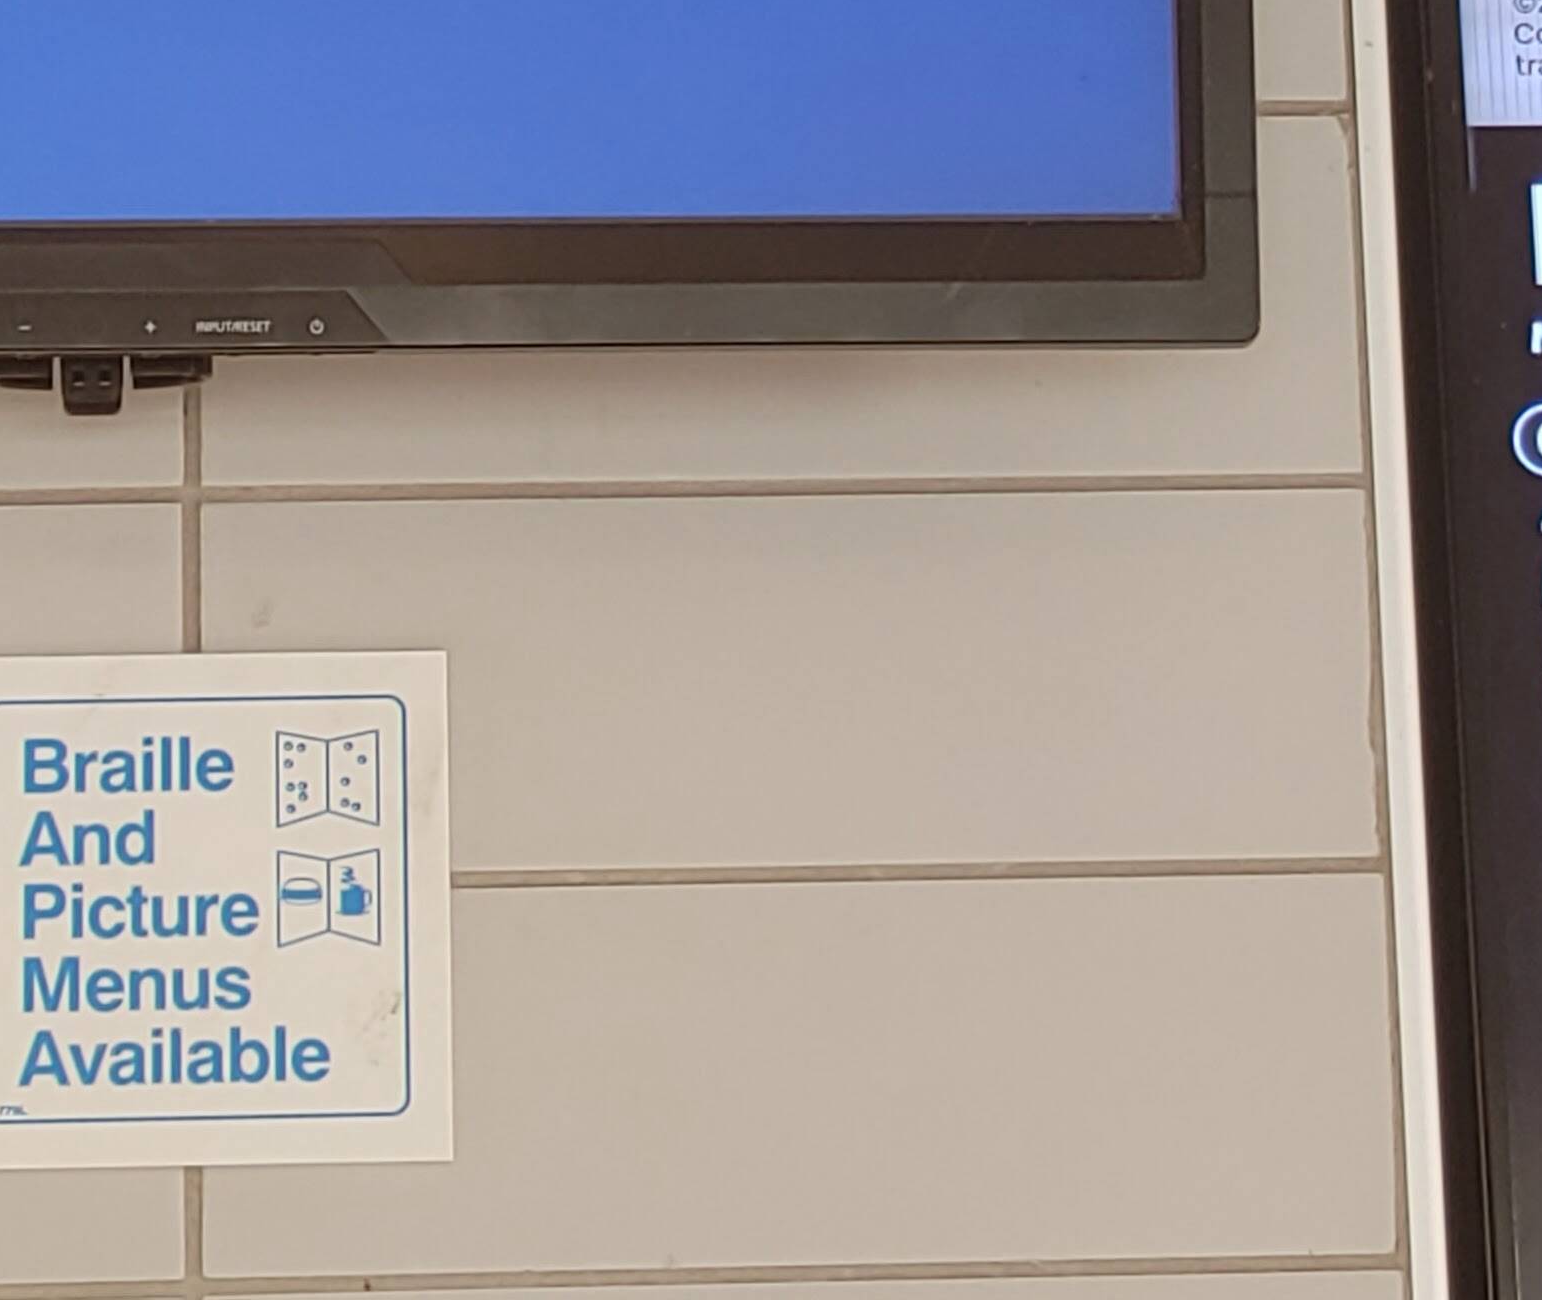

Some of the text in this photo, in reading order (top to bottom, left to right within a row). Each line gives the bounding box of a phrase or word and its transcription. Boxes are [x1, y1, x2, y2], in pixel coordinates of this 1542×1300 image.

[195, 319, 272, 334] INPUT/RESET
[21, 735, 235, 795] Braille
[18, 808, 156, 868] And
[21, 882, 260, 941] Picture
[21, 954, 253, 1014] Menus
[17, 1024, 331, 1088] Available
